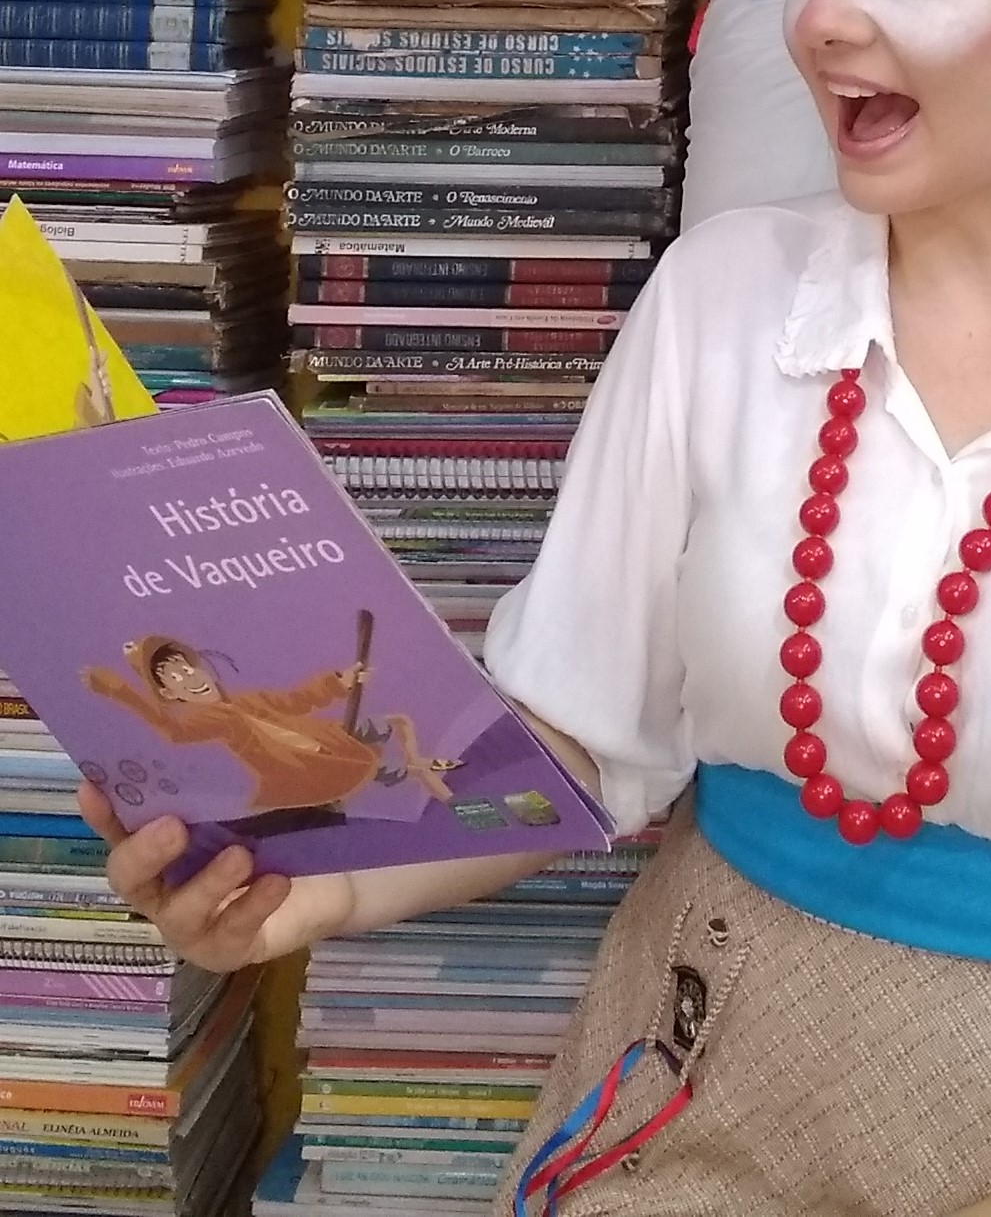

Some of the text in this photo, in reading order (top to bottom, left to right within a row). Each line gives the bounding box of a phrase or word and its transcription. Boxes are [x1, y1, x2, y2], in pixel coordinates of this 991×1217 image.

[400, 32, 472, 49] ESTUDOS
[479, 34, 498, 50] DE
[505, 34, 559, 51] CURSO
[322, 53, 555, 75] CURSO DE ESTUDOS SOCIAIS
[486, 124, 537, 136] Moderna
[293, 144, 511, 157] O MUNDO DA ARTE O Barroco
[8, 159, 64, 171] Matemática
[287, 188, 538, 206] O MUNDO DA ARTE O Renascimento
[298, 213, 361, 227] MUNDO
[362, 214, 381, 227] DA
[380, 214, 421, 227] ARTE
[443, 214, 494, 229] Mundo
[496, 214, 555, 230] Medieval
[40, 224, 75, 237] Biolog
[339, 241, 405, 254] Matemática
[385, 332, 481, 347] ENSINO INTEGRADO
[309, 356, 603, 371] MUNDO DA ARTE A Arte Pré-Histórica e Prim
[174, 437, 208, 450] Pedro
[207, 428, 254, 445] Campos
[217, 441, 265, 460] Azevedo
[150, 483, 310, 537] História
[123, 537, 345, 598] de Vaqueiro
[3, 702, 30, 715] BRASIL
[43, 1122, 87, 1135] ELINÉIA
[90, 1128, 140, 1139] ALMEIDA
